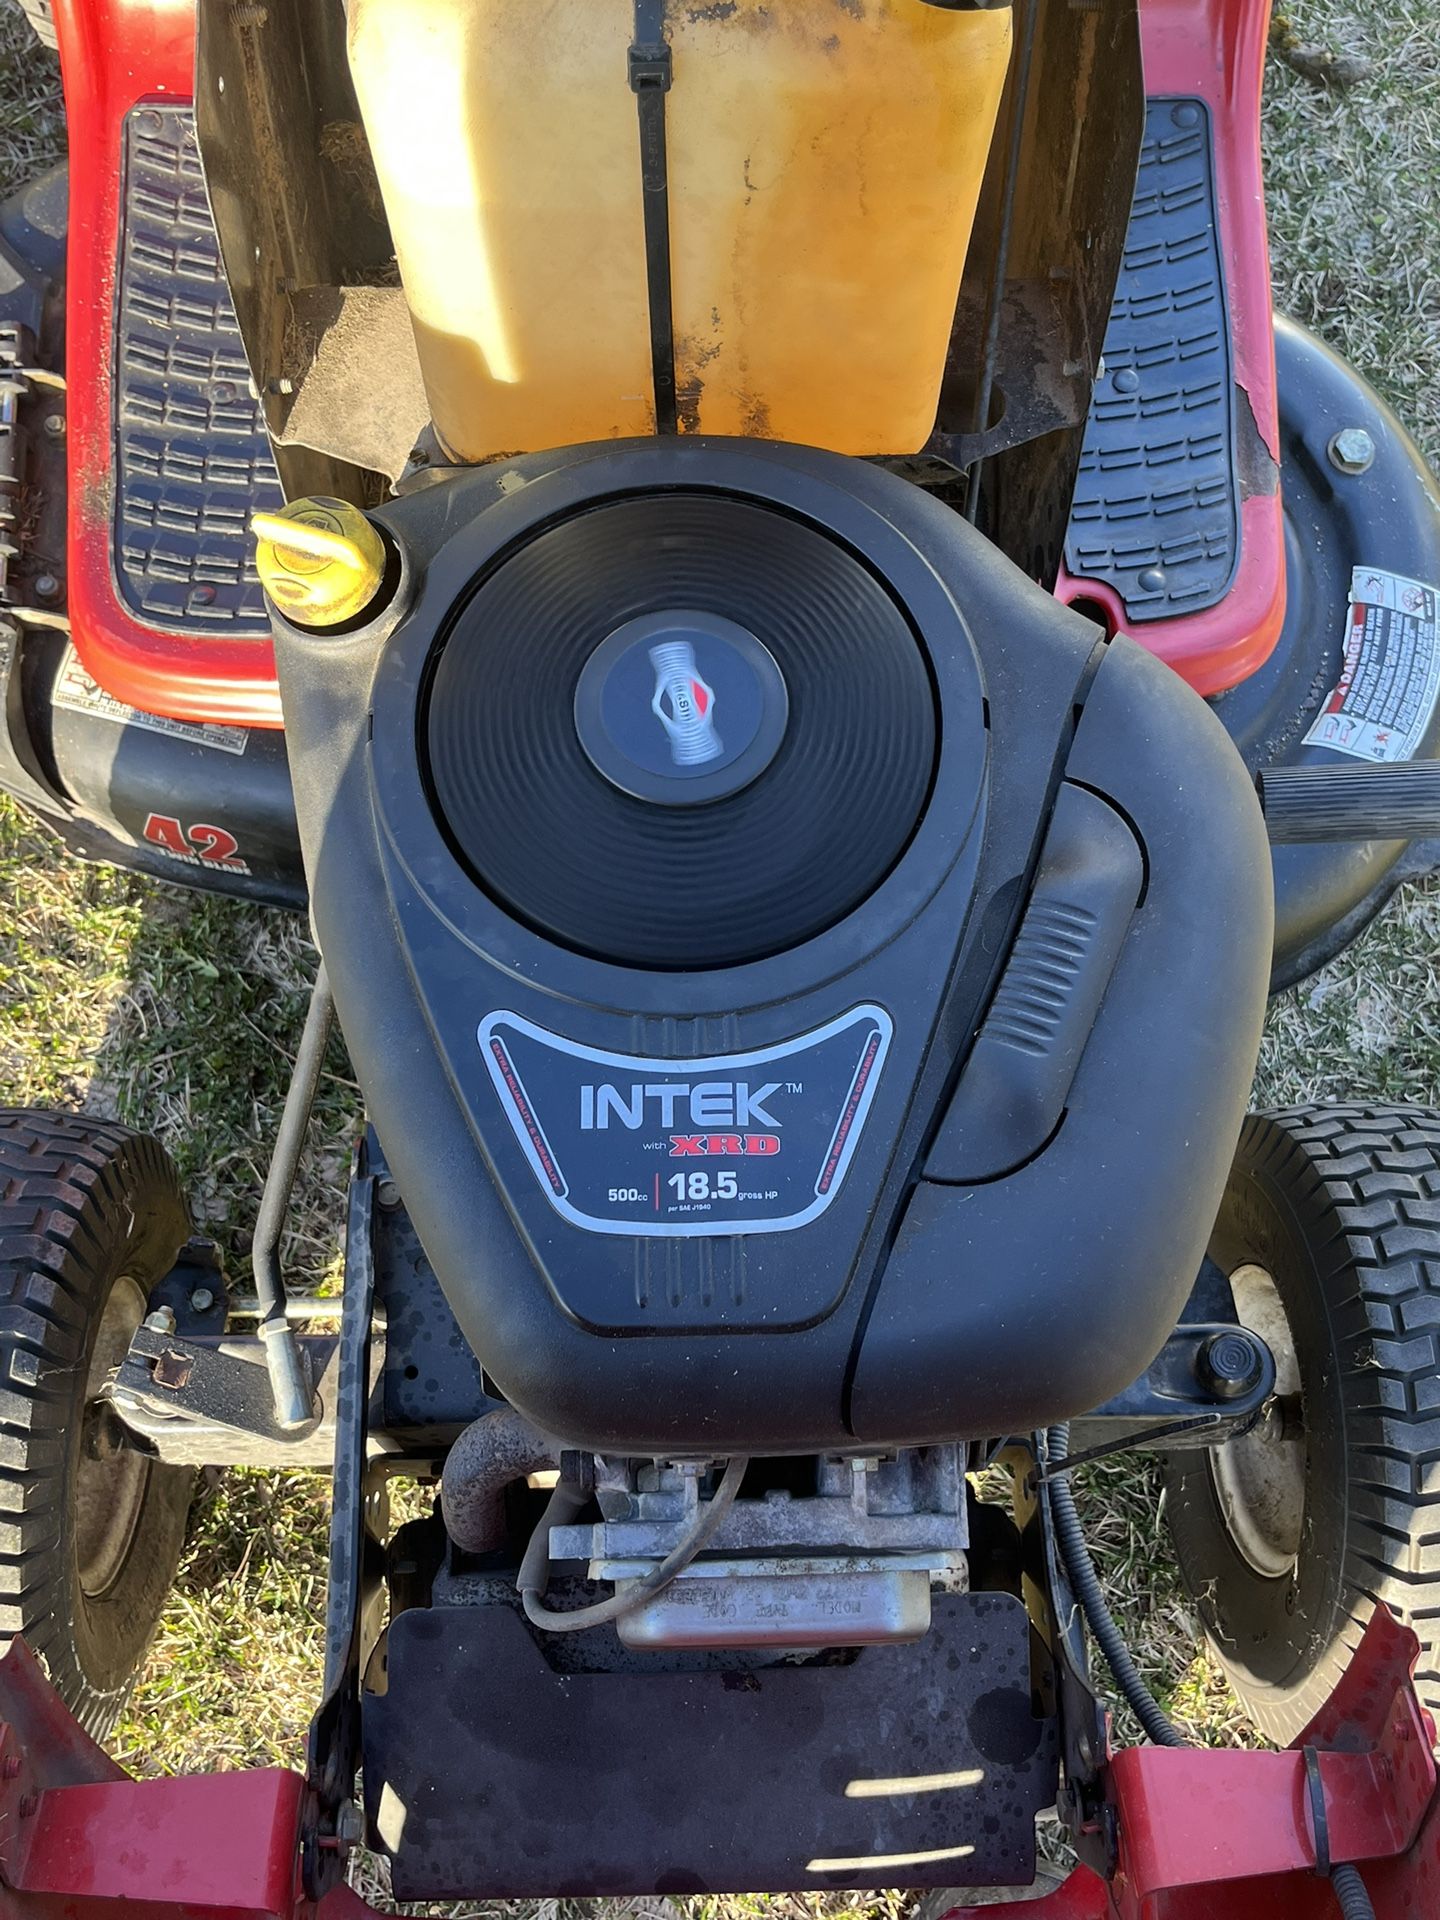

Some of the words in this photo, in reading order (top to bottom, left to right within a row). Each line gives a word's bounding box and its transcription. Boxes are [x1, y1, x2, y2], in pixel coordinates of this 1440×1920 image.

[1340, 624, 1363, 684] DANGER
[144, 812, 246, 865] 42
[202, 857, 252, 876] BLADE
[491, 1042, 510, 1073] EXTRA
[504, 1073, 533, 1125] RELIABILITY
[531, 1134, 561, 1188] DURABILITY
[580, 1082, 783, 1130] INTEK
[786, 1082, 803, 1094] TM
[819, 1157, 837, 1189] EXTRA
[831, 1103, 857, 1156] RELIABILITY
[853, 1039, 880, 1093] DURABILITY
[642, 1142, 666, 1150] with
[669, 1134, 780, 1156] XRD
[668, 1172, 738, 1200] 18.5
[738, 1192, 762, 1202] gross
[765, 1191, 778, 1200] HP
[679, 1204, 691, 1212] SAE
